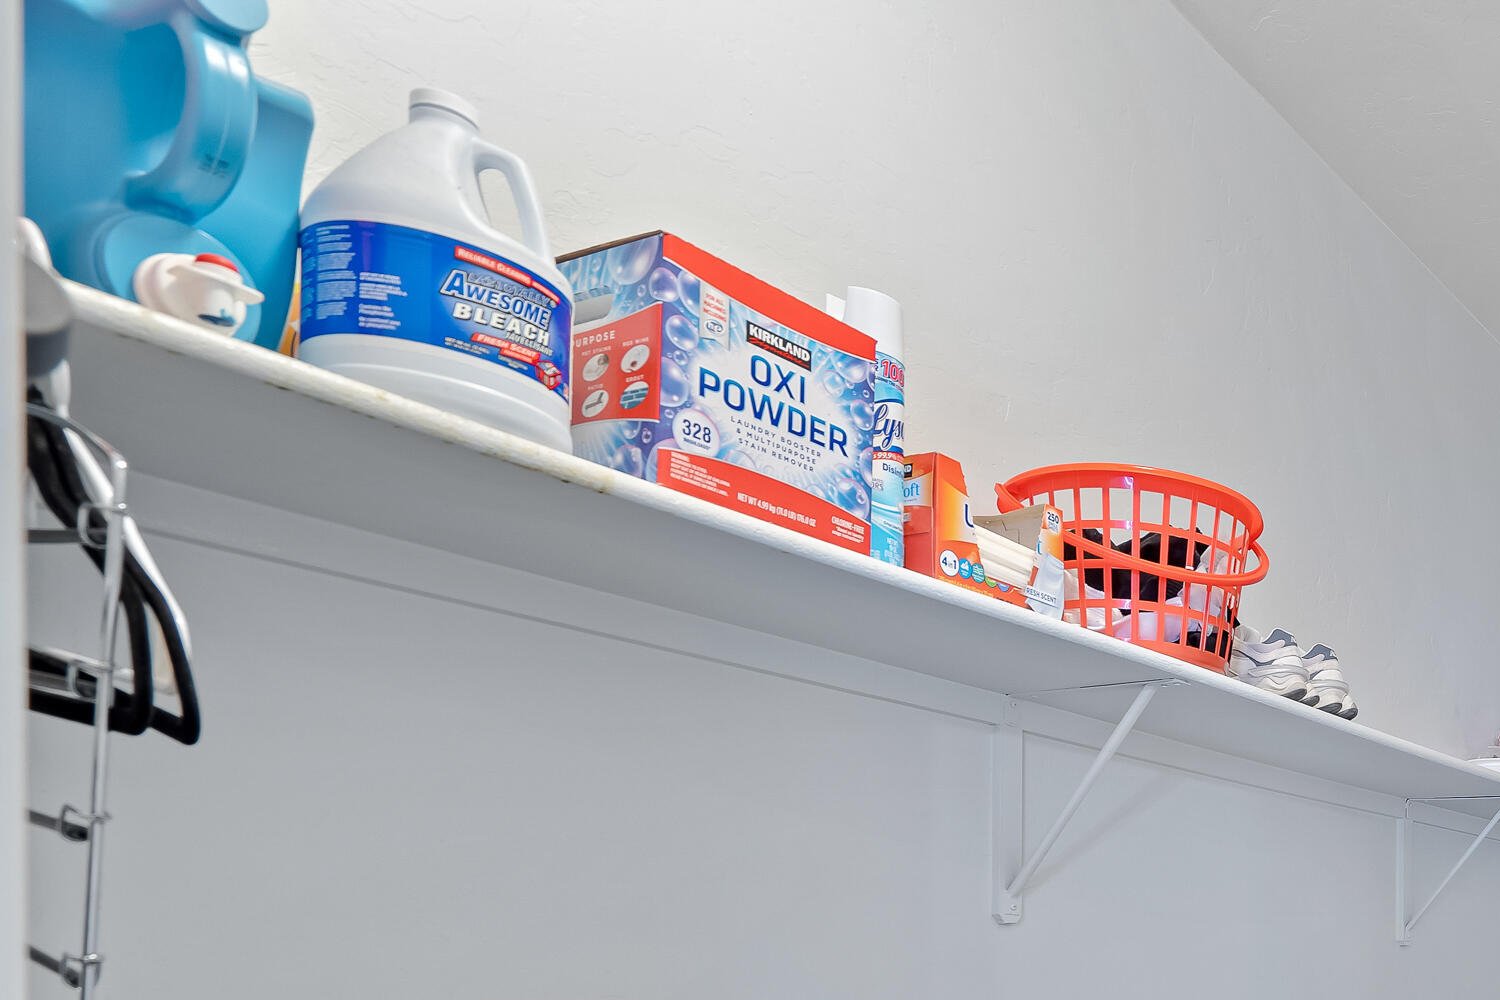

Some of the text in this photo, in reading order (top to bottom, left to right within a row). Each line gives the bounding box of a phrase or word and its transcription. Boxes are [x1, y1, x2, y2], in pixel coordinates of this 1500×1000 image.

[457, 248, 531, 284] RELIABLE CLEANING
[440, 269, 552, 330] AWESOME
[453, 302, 550, 346] BLEACH
[476, 334, 509, 349] FRESH
[509, 342, 537, 358] SCENT
[749, 324, 811, 362] KIRKLAND
[751, 355, 805, 404] OXI
[699, 367, 848, 458] POWDER
[682, 419, 711, 444] 328
[731, 416, 822, 458] LAUNDRY BOOSTER
[746, 432, 817, 465] MULTIPURPOSE
[738, 438, 815, 472] STAIN REMOVER
[1047, 511, 1060, 524] 250
[942, 556, 948, 566] 4
